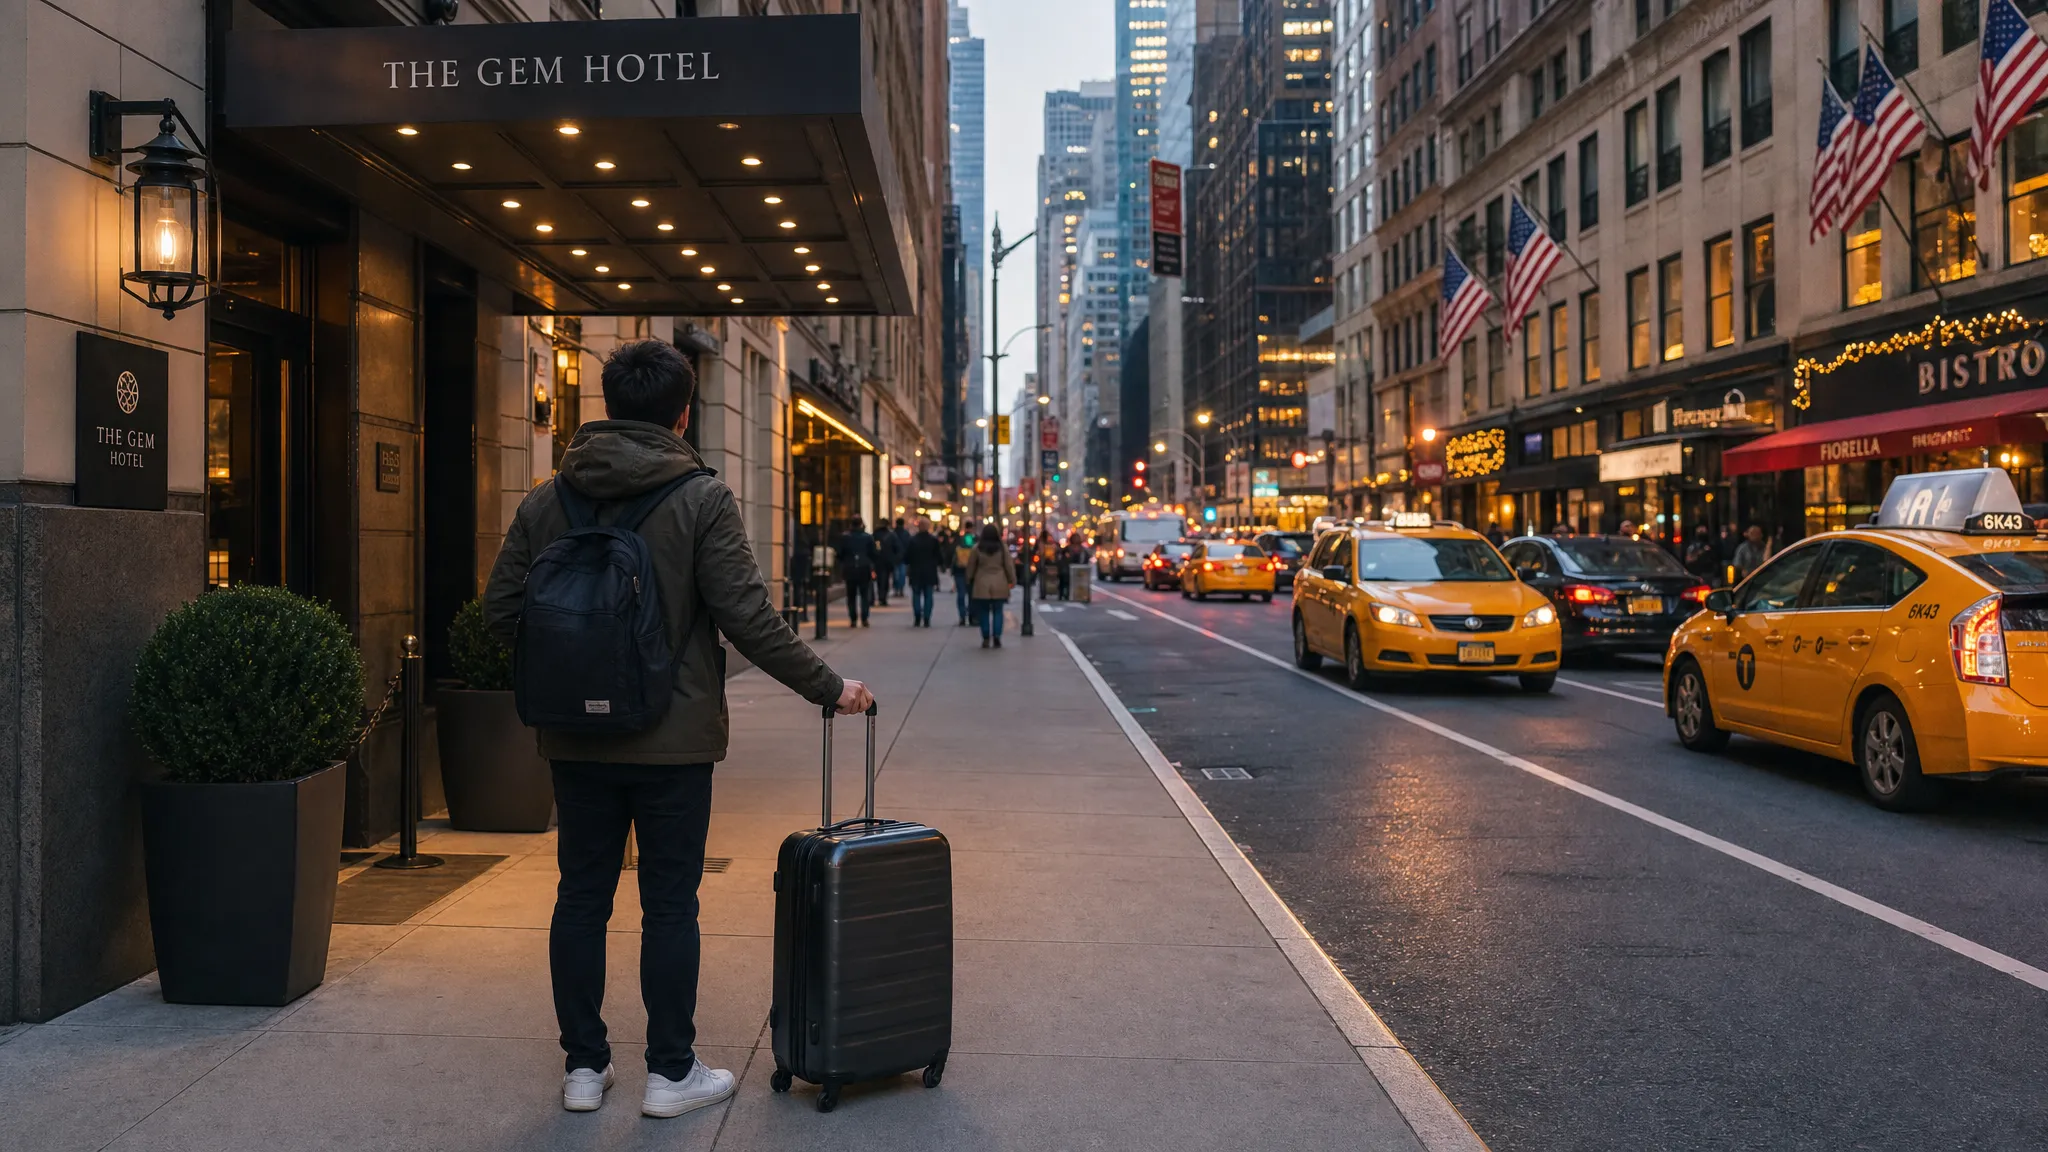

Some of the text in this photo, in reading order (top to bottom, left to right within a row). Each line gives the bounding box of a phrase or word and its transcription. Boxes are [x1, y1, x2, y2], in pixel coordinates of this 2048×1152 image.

[383, 52, 720, 89] THE GEM HOTEL
[1918, 340, 2046, 395] BISTRO
[96, 426, 155, 449] THE GEM
[1820, 437, 1881, 461] FIORELLA
[110, 451, 144, 468] HOTEL
[1983, 514, 2023, 530] 6K43
[1907, 603, 1941, 620] 6K43
[1740, 652, 1753, 686] T
